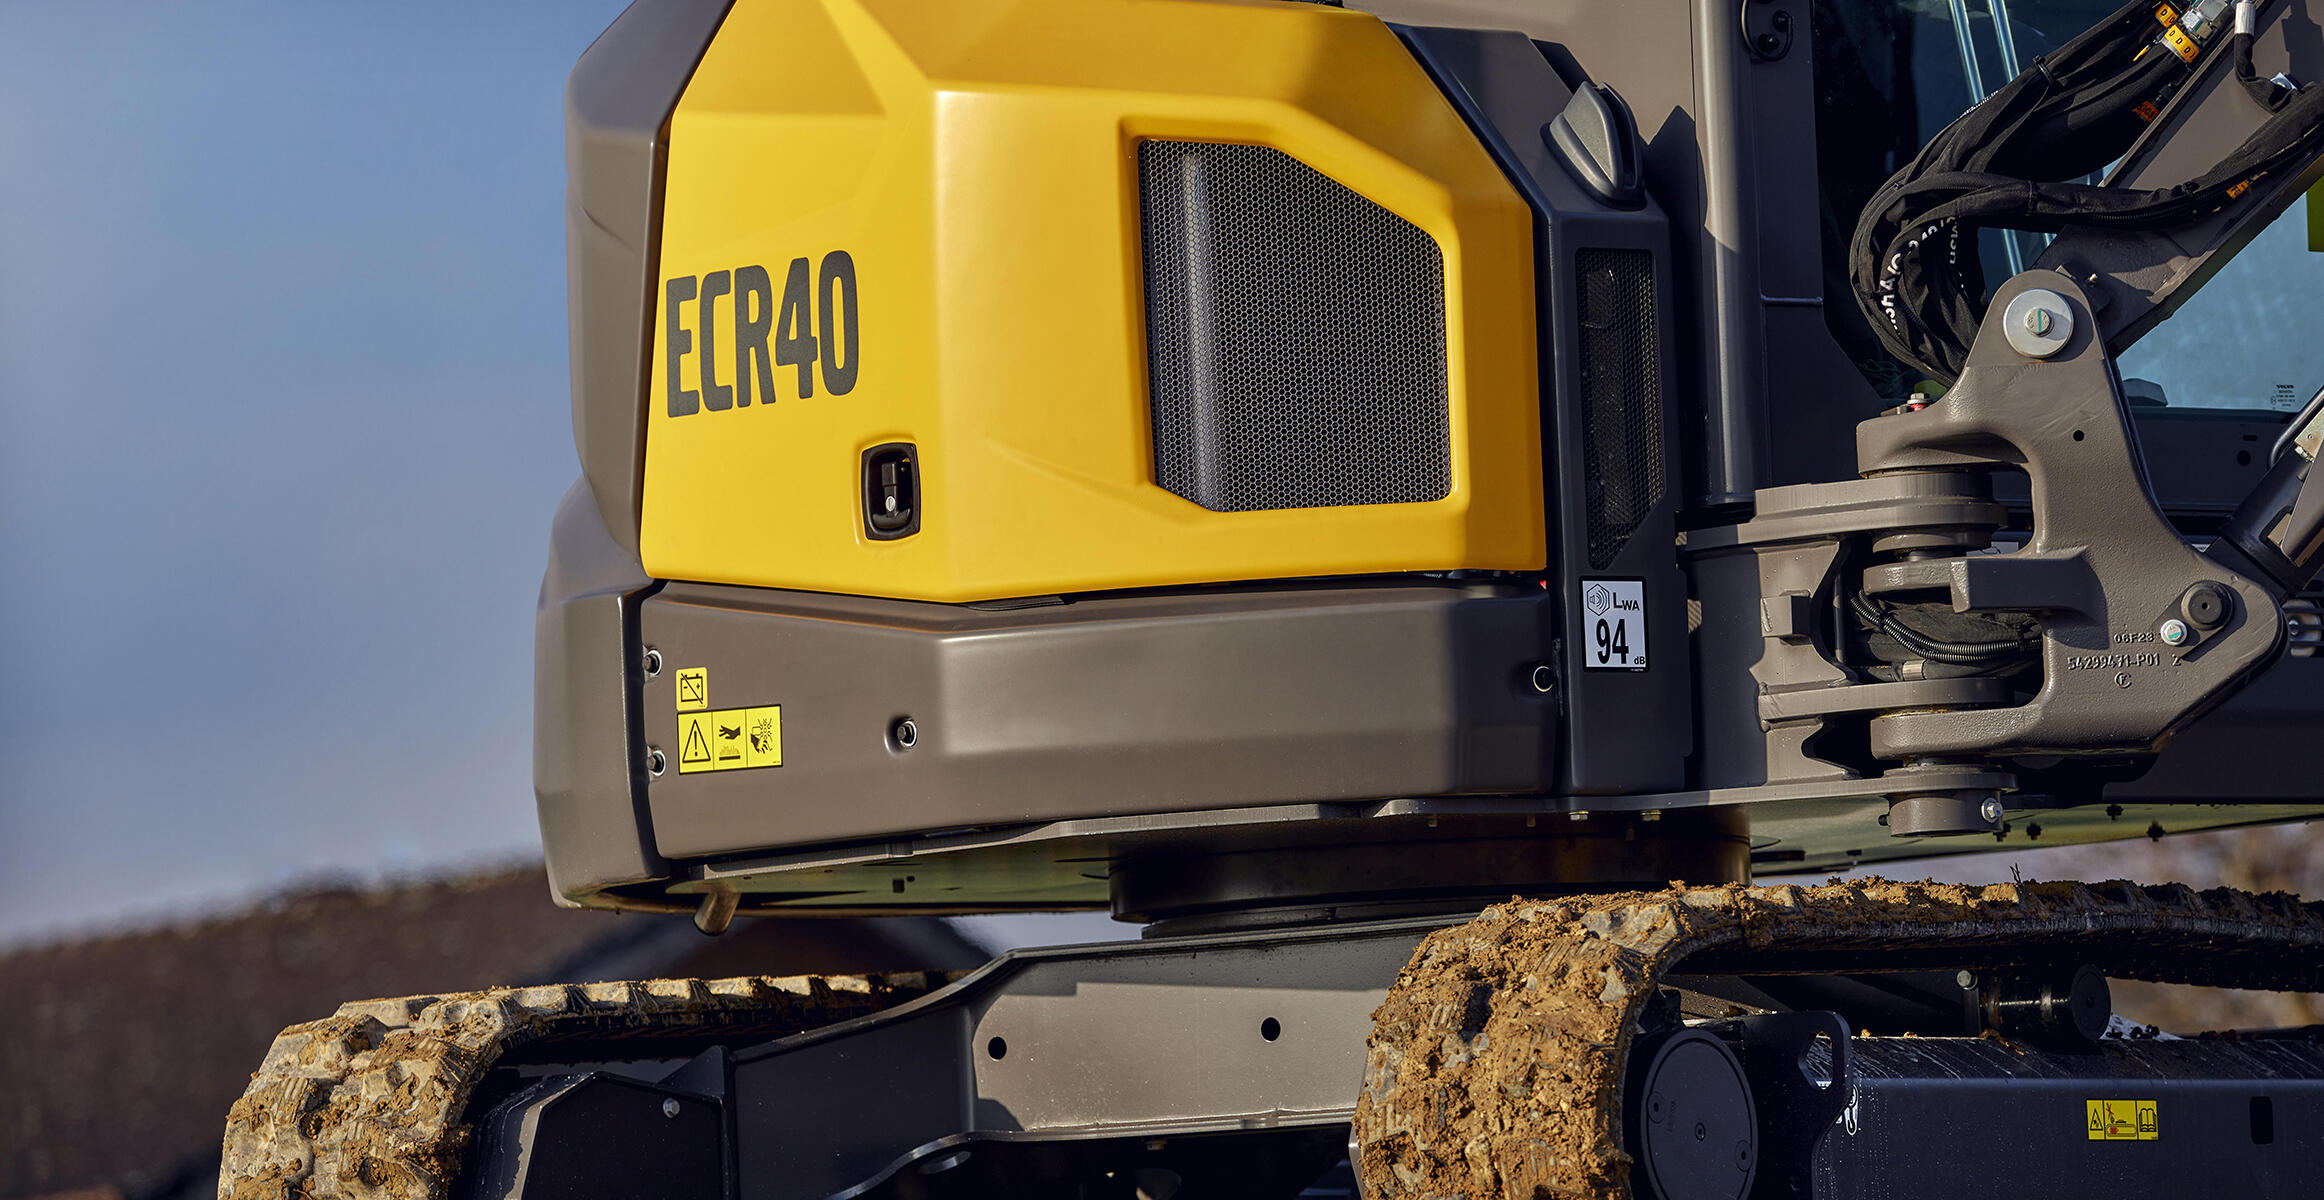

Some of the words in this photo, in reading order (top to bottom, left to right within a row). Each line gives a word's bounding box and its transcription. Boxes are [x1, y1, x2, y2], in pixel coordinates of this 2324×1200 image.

[666, 250, 859, 418] ECR40
[1596, 618, 1630, 665] 94
[1633, 656, 1646, 665] dB
